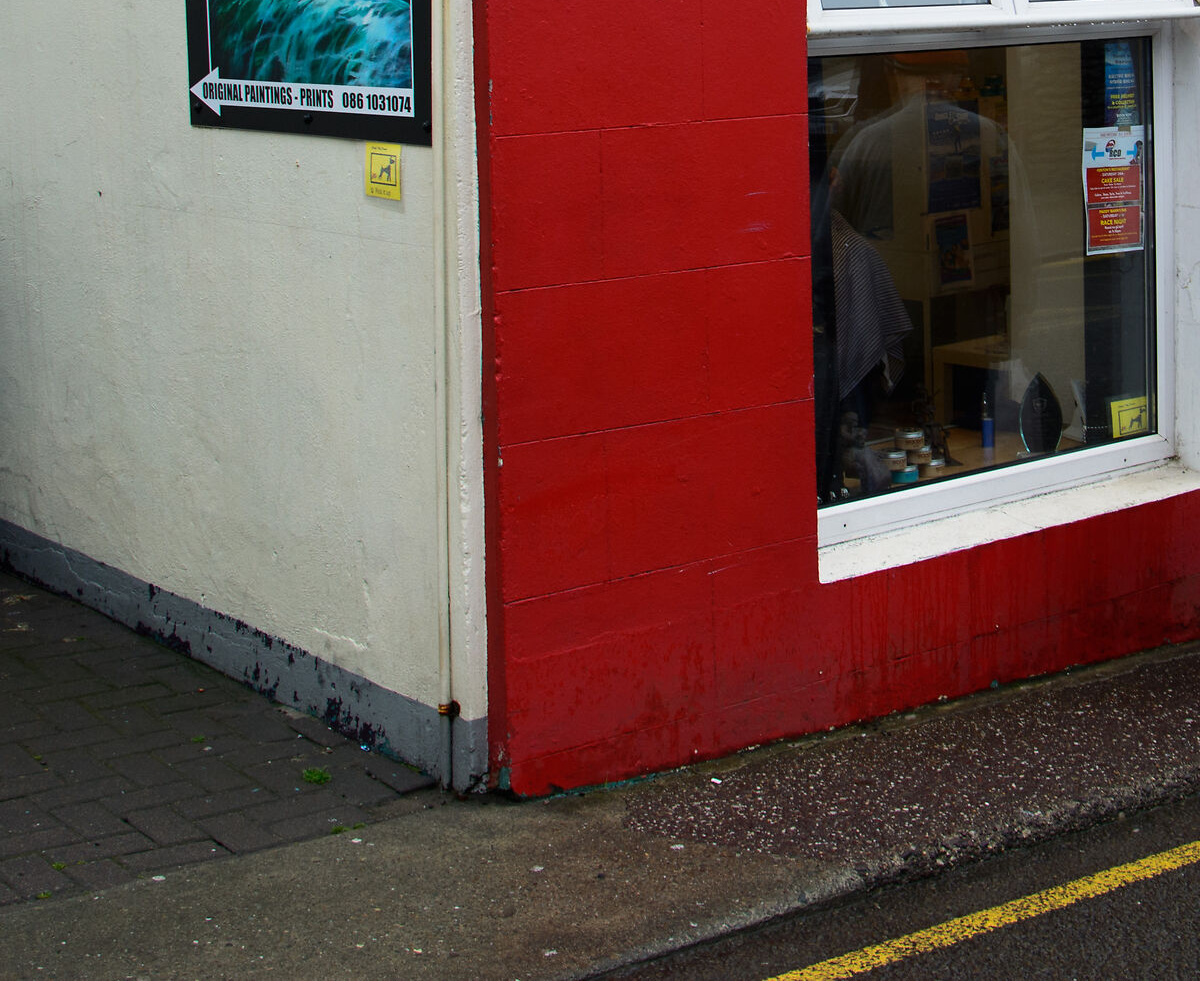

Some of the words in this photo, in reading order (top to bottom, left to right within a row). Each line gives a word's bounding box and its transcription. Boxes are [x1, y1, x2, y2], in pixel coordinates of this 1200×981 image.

[202, 81, 243, 102] ORIGINAL
[244, 84, 293, 106] PAINTINGS
[300, 88, 334, 108] PRINTS
[342, 92, 364, 109] 086
[366, 93, 412, 113] 1031074
